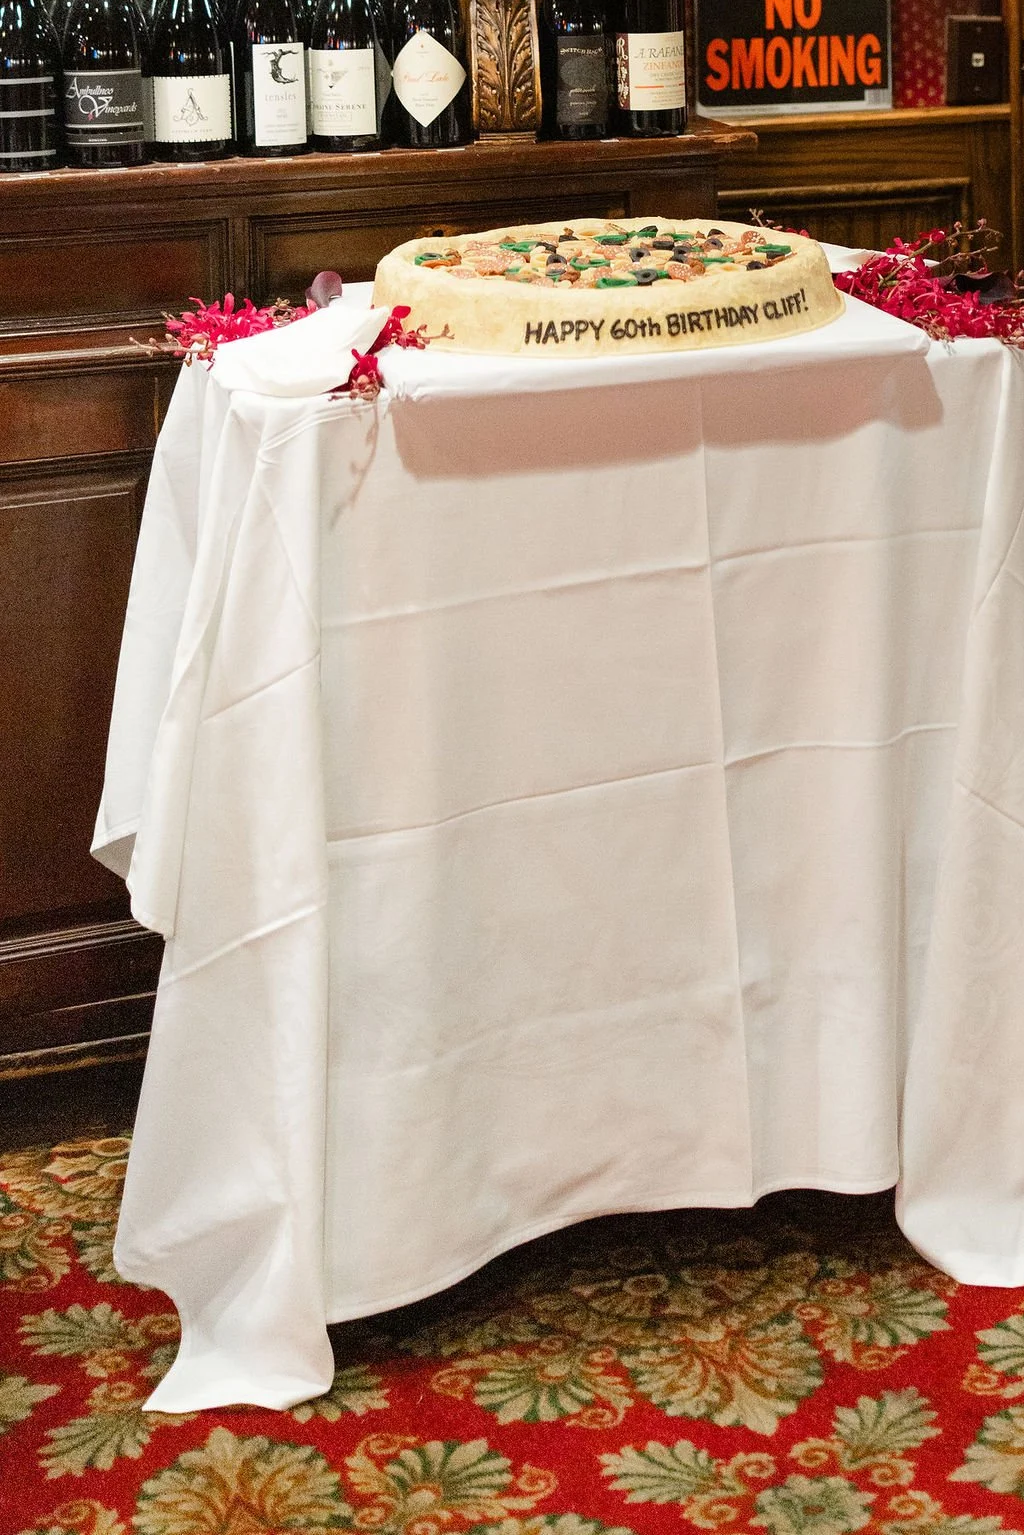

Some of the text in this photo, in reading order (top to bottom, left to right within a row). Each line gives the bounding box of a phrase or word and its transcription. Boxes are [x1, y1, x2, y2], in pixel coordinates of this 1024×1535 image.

[705, 32, 882, 92] SMOKING
[524, 289, 809, 345] HAPPY 60th BIRTHDAY CLIFF!
